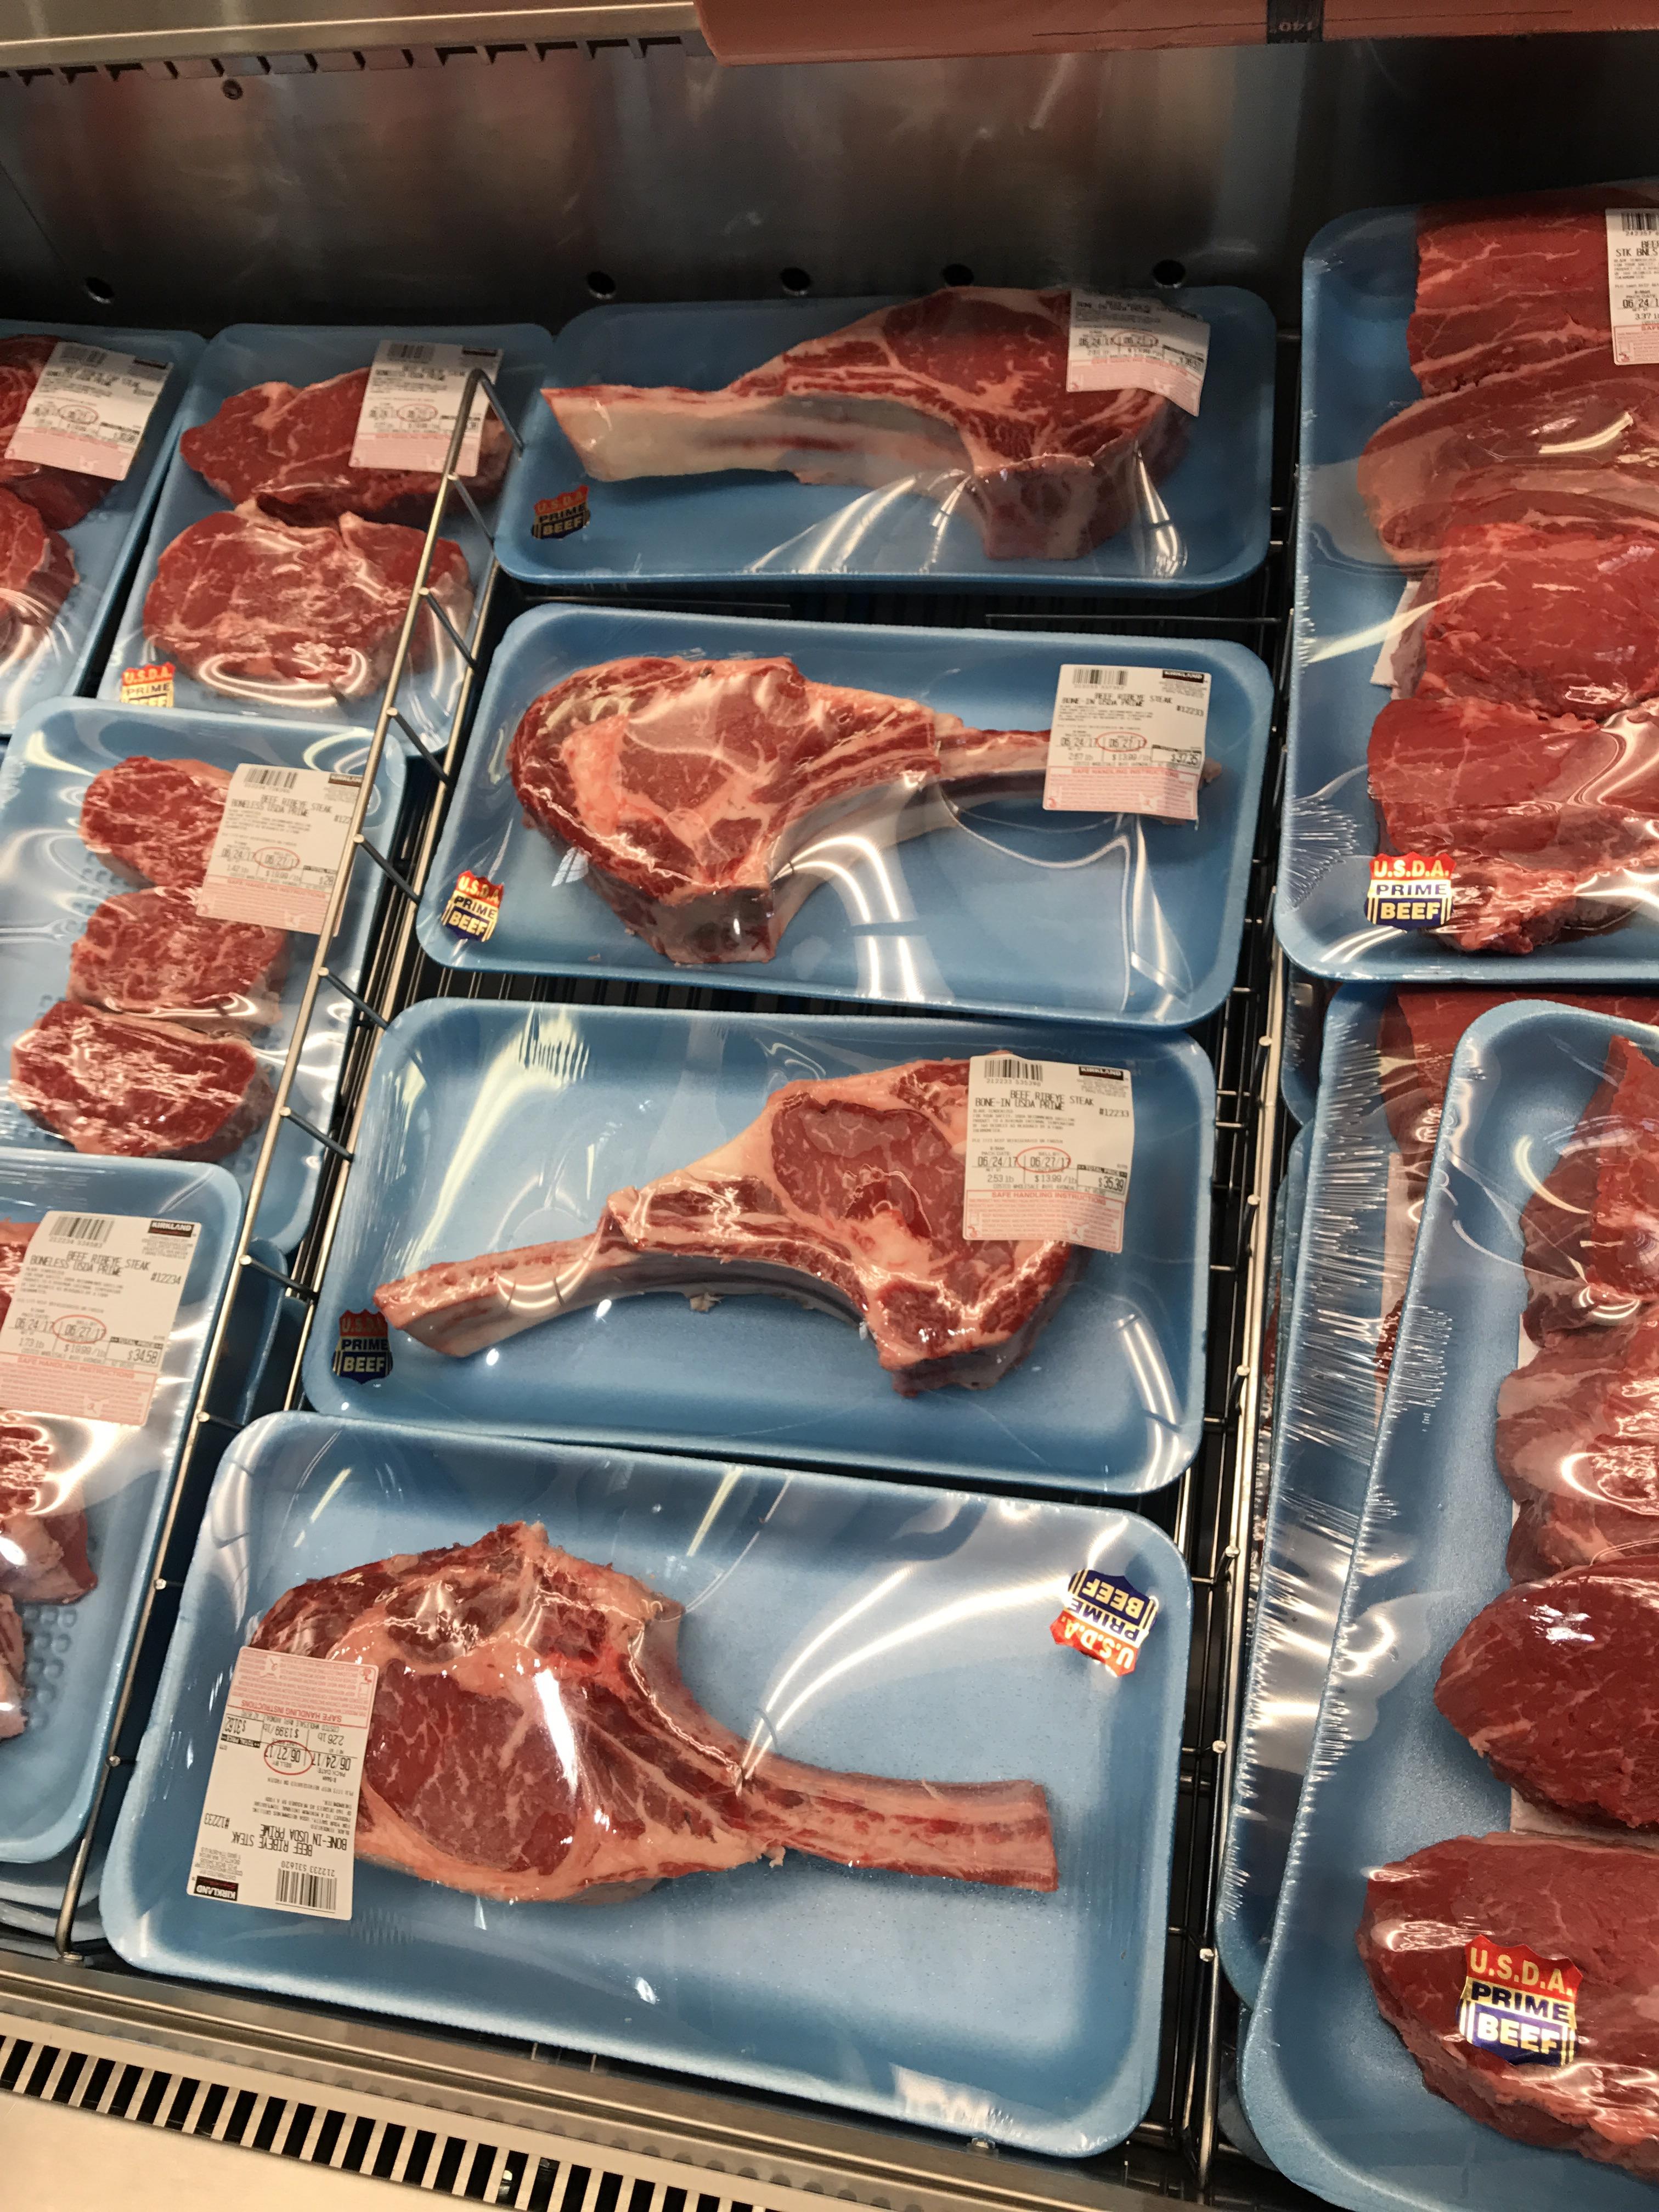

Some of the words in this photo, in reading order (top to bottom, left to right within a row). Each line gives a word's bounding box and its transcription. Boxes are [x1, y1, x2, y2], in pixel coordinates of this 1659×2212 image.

[1616, 248, 1632, 257] STK
[1623, 298, 1659, 308] 06/24/1
[543, 517, 582, 536] BEEF
[127, 682, 171, 695] PRIME
[1374, 860, 1449, 877] U.S.D.A.
[1376, 884, 1447, 895] PRIME
[454, 895, 497, 919] PRIME
[1380, 902, 1441, 920] BEEF
[448, 911, 488, 936] BEEF
[975, 1097, 1011, 1107] BONE-IN
[1015, 1098, 1036, 1108] USDA
[1040, 1099, 1065, 1111] PRIME
[1011, 1090, 1031, 1099] BEEF
[1035, 1092, 1065, 1103] RIBEYE
[1070, 1096, 1094, 1106] STEAK
[1099, 1108, 1130, 1117] #12233
[30, 1255, 71, 1268] BONELESS
[72, 1262, 93, 1271] USDA
[66, 1251, 88, 1261] BEEF
[125, 1259, 150, 1270] STEAK
[151, 1273, 181, 1283] #12234
[342, 1339, 388, 1350] PRIME
[127, 1348, 158, 1363] $34.58
[343, 1356, 385, 1372] BEEF
[1081, 1578, 1145, 1619] BEEF
[1067, 1598, 1140, 1641] PRIME
[1061, 1616, 1135, 1669] U.S.D.A.
[241, 1700, 283, 1713] INSTRUCTIONS
[285, 1708, 320, 1718] HANDLING
[312, 1753, 350, 1770] 06/24/17
[203, 1812, 230, 1830] #12233
[230, 1832, 254, 1846] STEAK
[259, 1824, 285, 1838] PRIME
[289, 1829, 308, 1842] USDA
[258, 1836, 289, 1852] RIBEYE
[294, 1842, 312, 1855] BEEF
[312, 1834, 347, 1850] BONE-IN
[310, 1866, 334, 1876] 212233
[196, 1884, 235, 1898] KIRKLAND
[1470, 1947, 1573, 1996] U.S.D.A.
[1471, 1981, 1571, 2023] PRIME
[1477, 2012, 1560, 2054] BEEF
